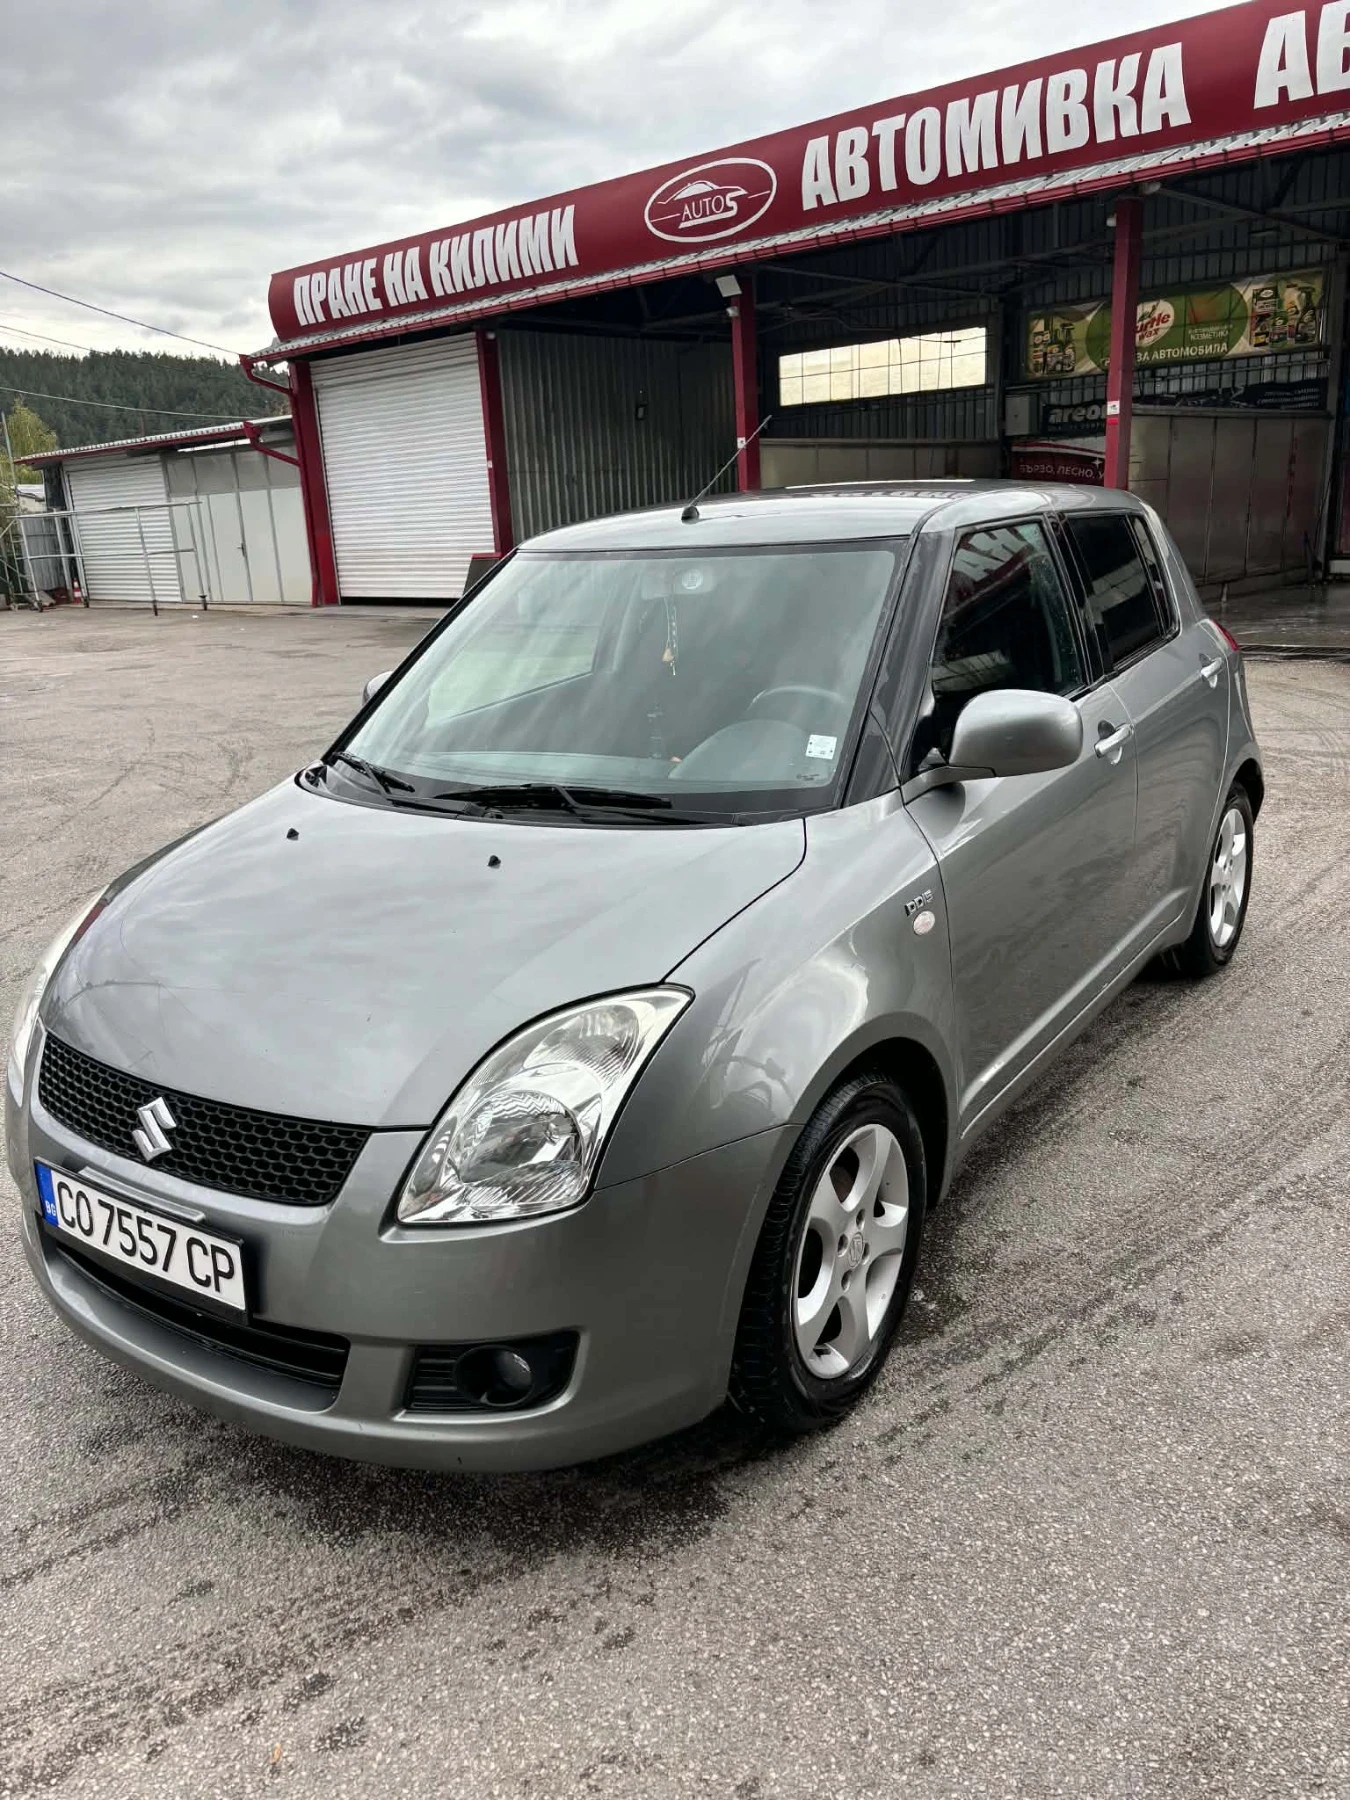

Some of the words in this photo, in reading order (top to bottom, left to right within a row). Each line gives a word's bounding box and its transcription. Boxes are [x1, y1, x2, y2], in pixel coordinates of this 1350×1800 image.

[801, 42, 1192, 211] АВТОМИВКА
[293, 259, 381, 326] ПРАНЕ
[383, 246, 429, 307] НА
[429, 204, 579, 297] КИЛИМИ
[1135, 312, 1171, 334] urtle
[1139, 327, 1160, 341] wax
[1136, 352, 1150, 362] ЗА
[1152, 342, 1229, 361] АВТОМОБИЛА
[45, 1200, 57, 1217] BG
[98, 1199, 177, 1272] 7557
